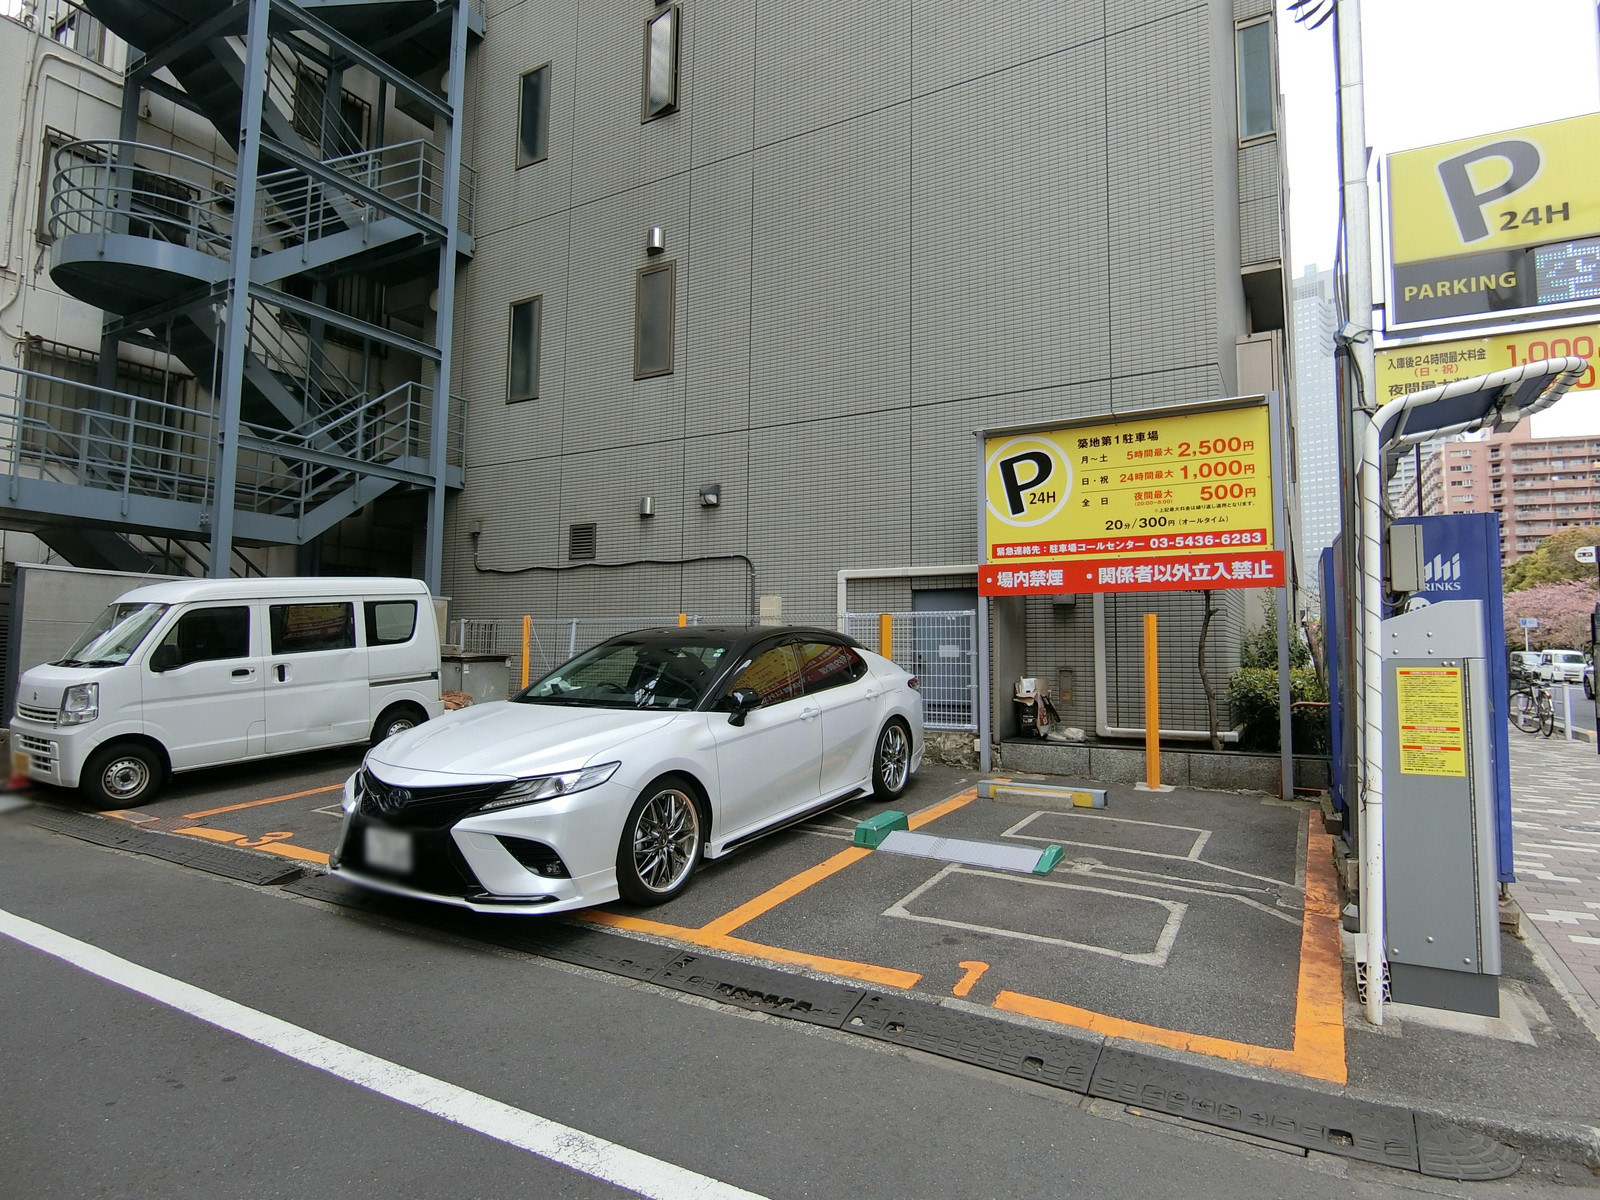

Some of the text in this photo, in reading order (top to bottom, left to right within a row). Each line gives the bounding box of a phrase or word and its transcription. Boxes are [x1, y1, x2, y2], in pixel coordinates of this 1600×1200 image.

[1438, 140, 1541, 243] P
[1499, 202, 1570, 231] 24H
[1404, 271, 1518, 302] PARKING
[1387, 347, 1487, 371] 入庫後24時間最大料金
[1077, 430, 1160, 450] 築地第1駐車場
[1080, 436, 1255, 465] 月～土 5時間最大 2,500円
[998, 450, 1053, 516] P
[1081, 459, 1256, 486] 日・祝 24時間最大 1,000円
[1028, 490, 1057, 506] 24H
[1134, 489, 1174, 501] 夜間最大
[1199, 482, 1257, 502] 500円
[1149, 531, 1263, 550] 03-5436-6283
[951, 959, 990, 998] 1
